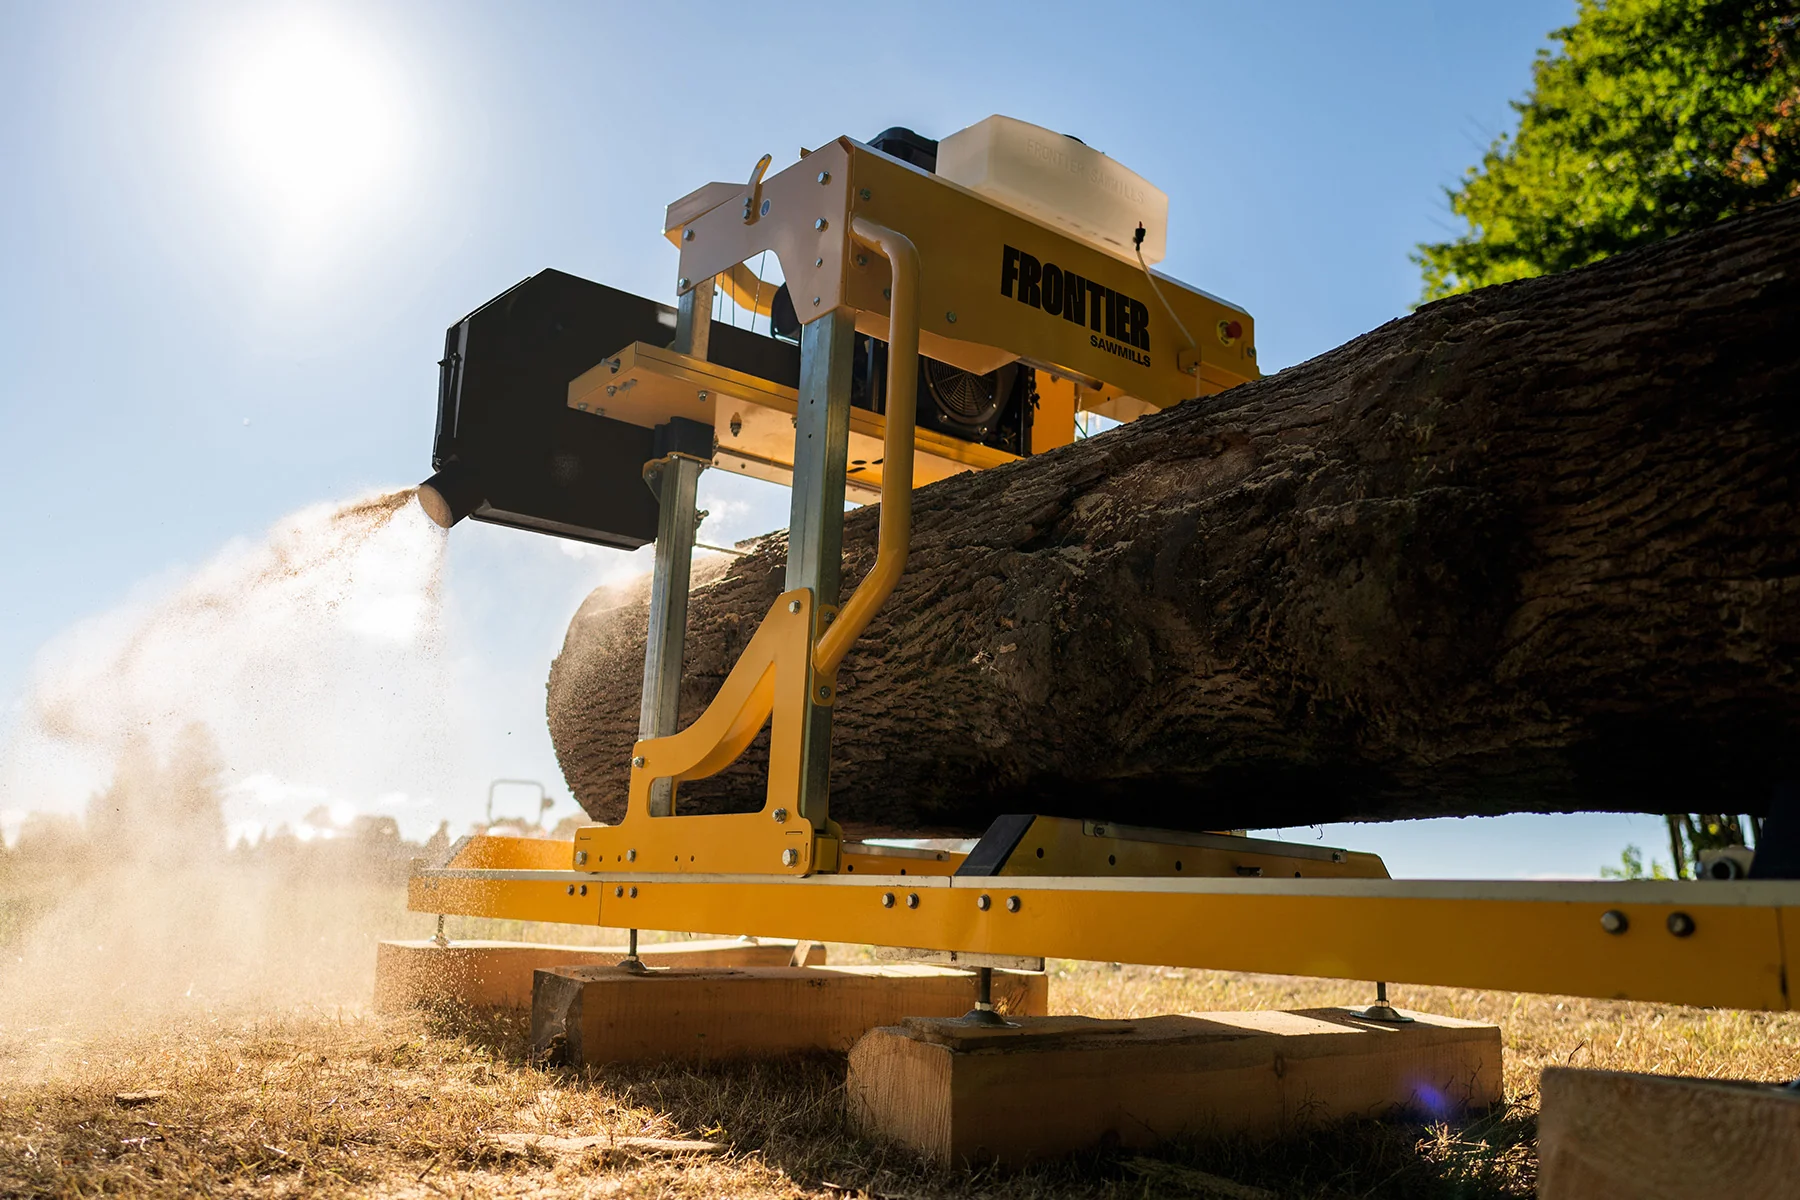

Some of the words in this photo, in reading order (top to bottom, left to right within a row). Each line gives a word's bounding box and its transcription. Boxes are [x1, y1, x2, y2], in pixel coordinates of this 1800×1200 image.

[1026, 138, 1085, 177] FRONTIER
[1089, 168, 1144, 204] SAWMILLS
[1001, 244, 1150, 352] FRONTIER
[1090, 334, 1151, 367] SAWMILLS
